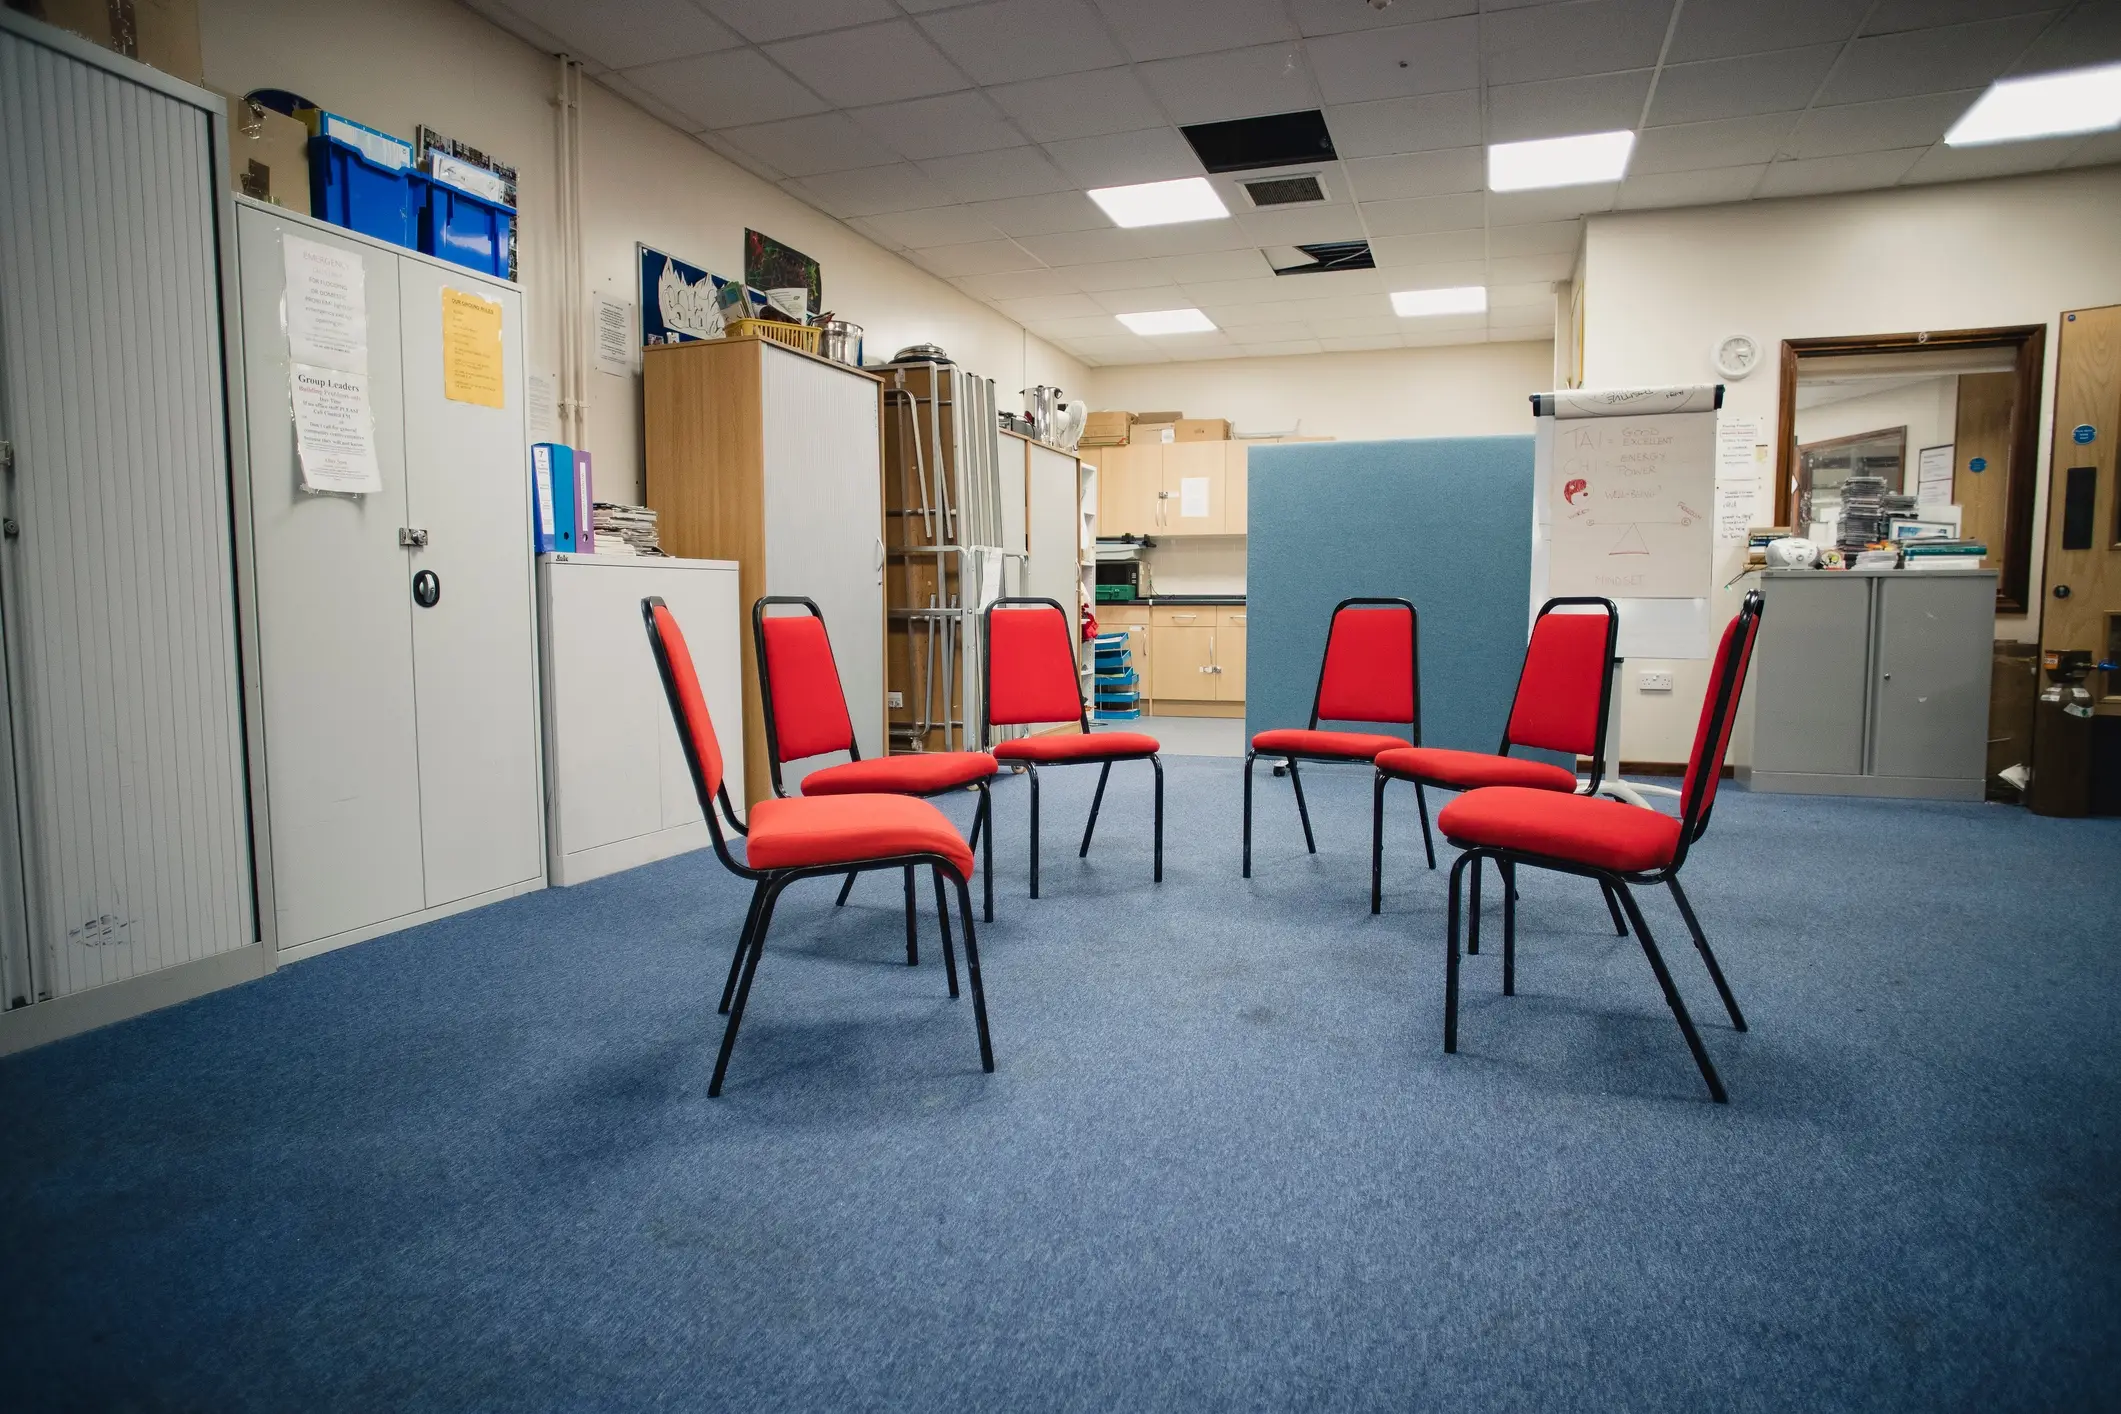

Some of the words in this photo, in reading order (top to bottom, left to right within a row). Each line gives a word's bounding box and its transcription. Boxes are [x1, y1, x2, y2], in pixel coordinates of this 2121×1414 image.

[302, 250, 350, 270] EMERGENCY
[462, 301, 480, 310] GROUND
[480, 306, 494, 315] RULES
[297, 374, 326, 388] Group
[326, 379, 360, 392] Leaders
[298, 385, 323, 395] Building
[1563, 425, 1602, 451] TAI
[1621, 426, 1661, 438] GOOD
[1622, 436, 1674, 447] EXCELLENT
[538, 450, 544, 458] 7
[1620, 451, 1667, 464] ENERGY
[1563, 457, 1599, 476] CHI
[1614, 464, 1658, 478] POWER
[1594, 575, 1646, 587] MINDSET
